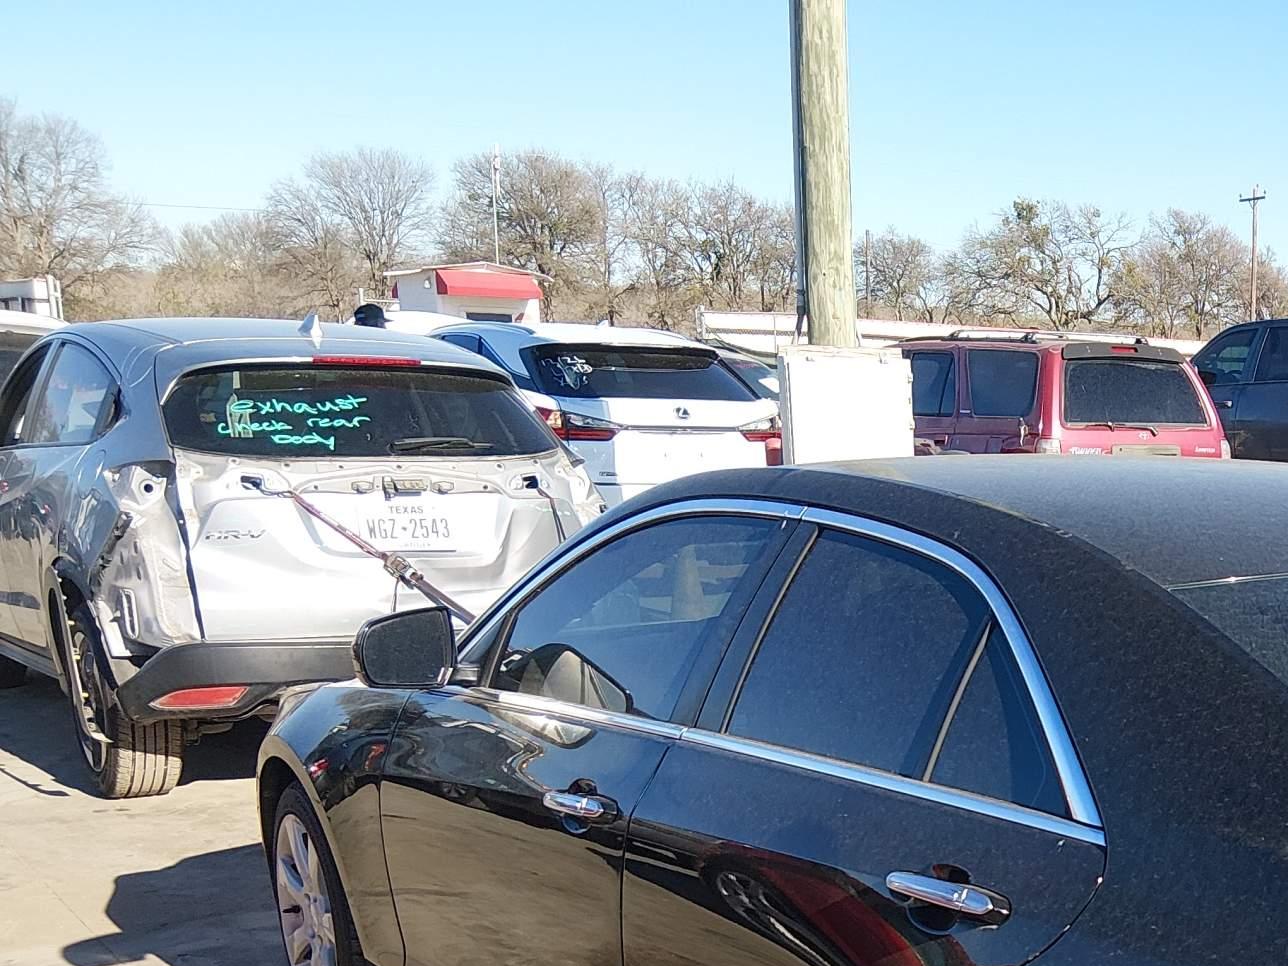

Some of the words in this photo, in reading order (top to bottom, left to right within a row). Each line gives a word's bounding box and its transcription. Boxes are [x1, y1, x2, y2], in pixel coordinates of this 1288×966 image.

[231, 395, 367, 414] exhaust
[307, 416, 371, 427] rear
[271, 432, 335, 450] body
[388, 505, 424, 514] TEXAS
